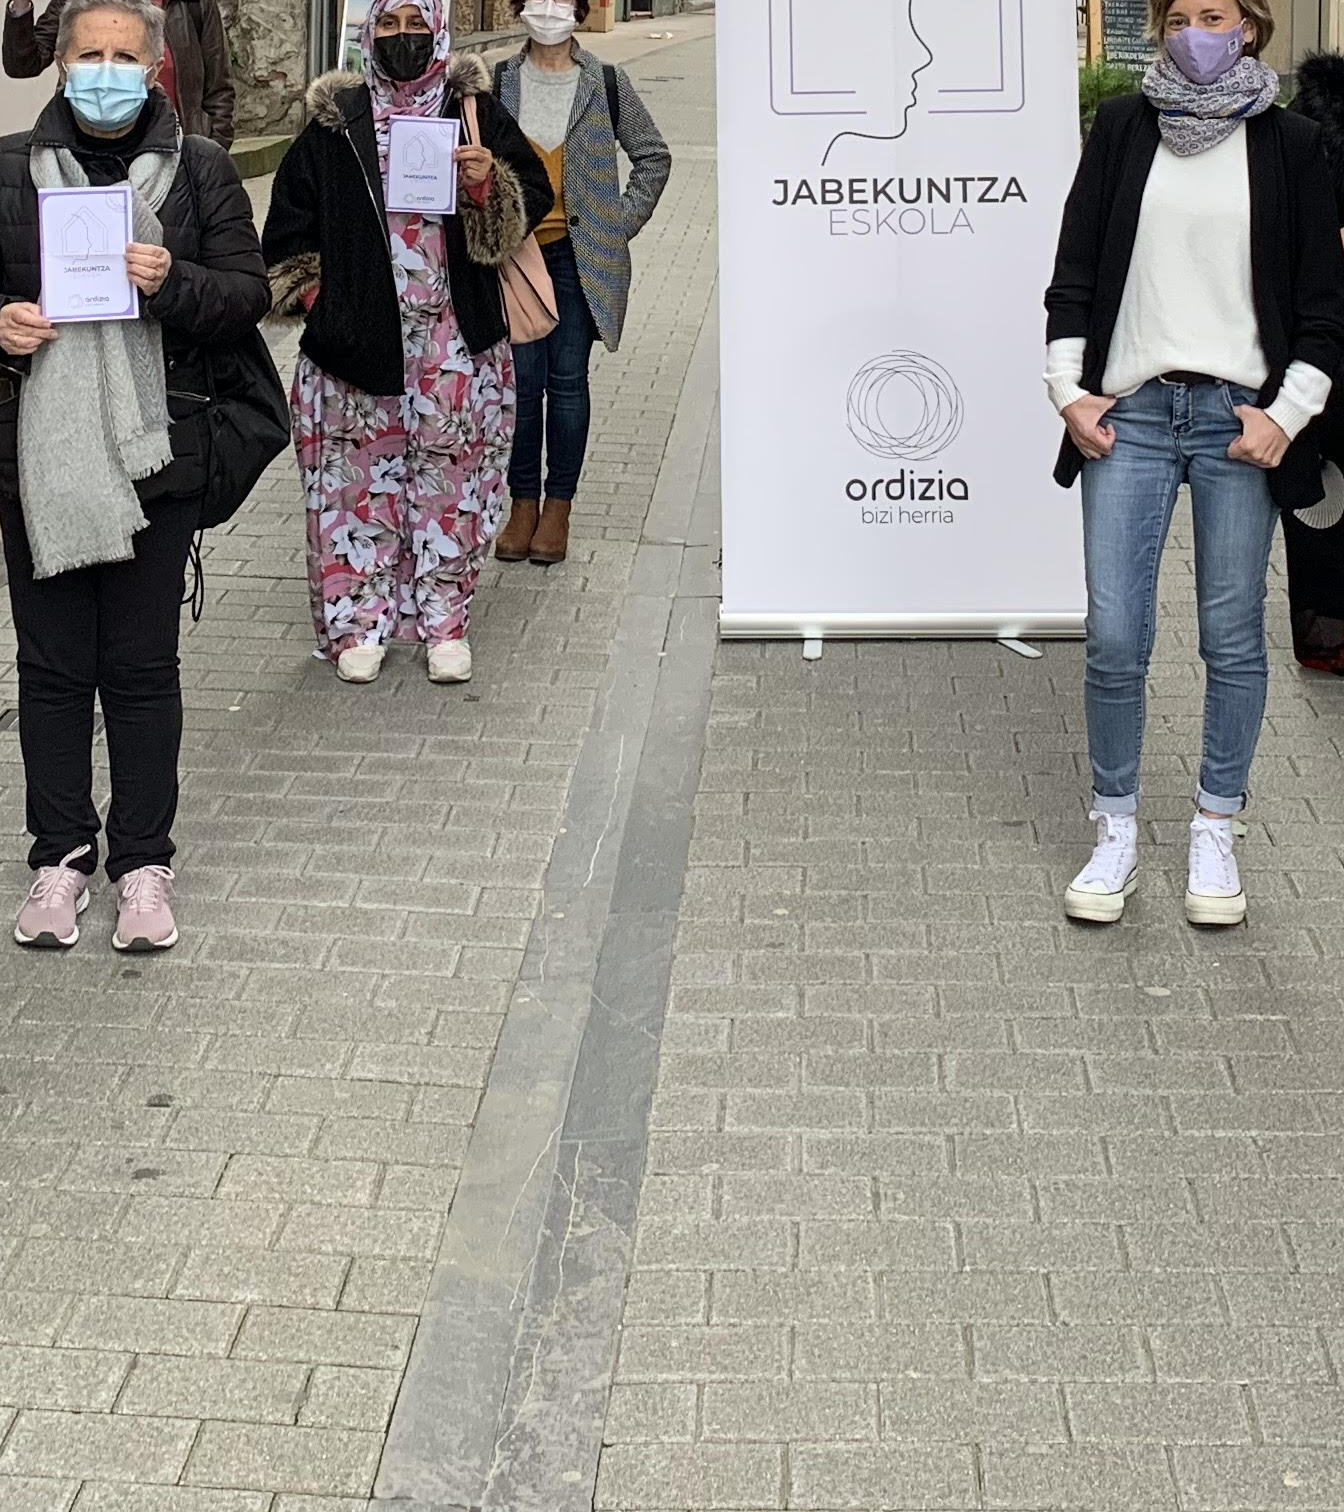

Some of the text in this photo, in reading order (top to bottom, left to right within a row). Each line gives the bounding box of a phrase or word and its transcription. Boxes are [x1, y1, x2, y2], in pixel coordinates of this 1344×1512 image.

[772, 176, 1028, 206] JABEKUNTZA
[829, 208, 975, 236] ESKOLA
[845, 468, 970, 502] ordizia
[860, 506, 954, 525] bizi herria
